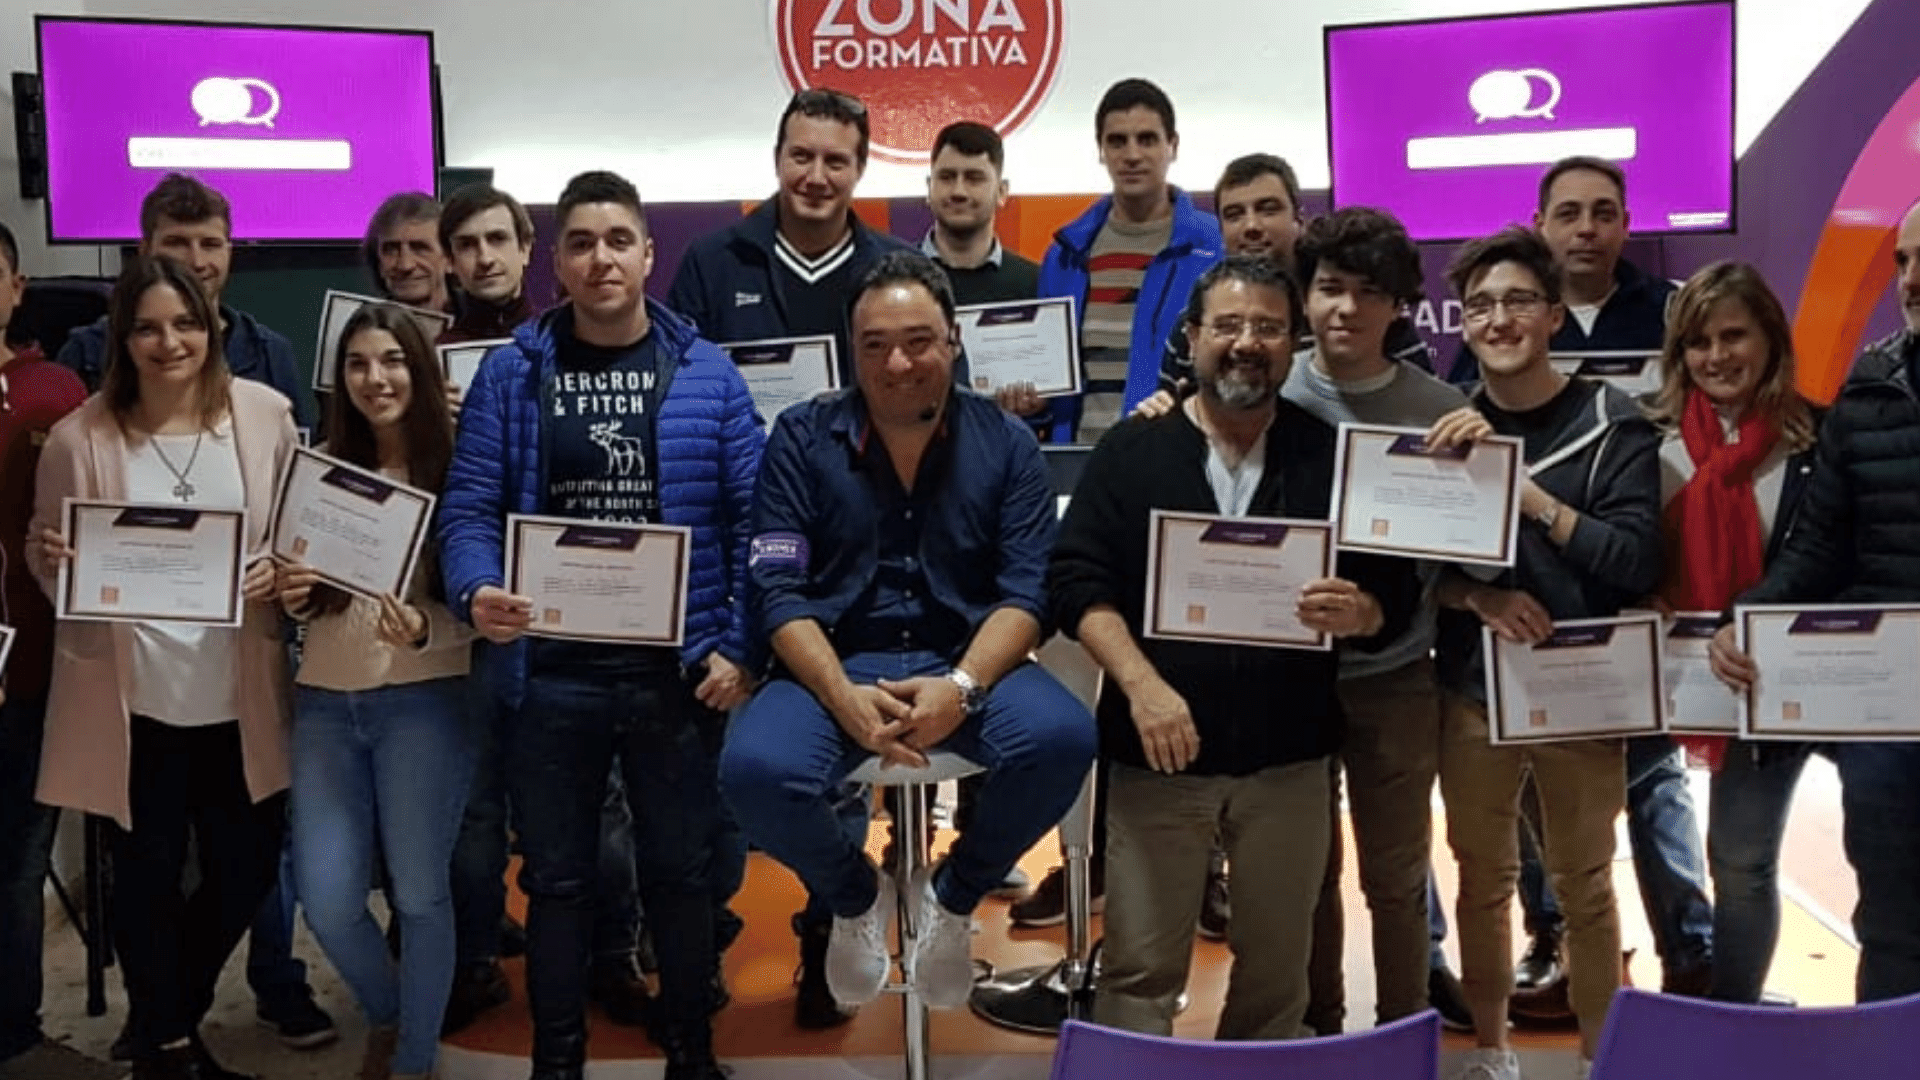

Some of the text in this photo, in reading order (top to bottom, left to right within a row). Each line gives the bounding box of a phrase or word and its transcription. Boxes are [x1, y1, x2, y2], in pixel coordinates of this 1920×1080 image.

[813, 0, 1027, 36] ZONA
[812, 36, 1028, 69] FORMATIVA
[577, 394, 644, 415] FITCH
